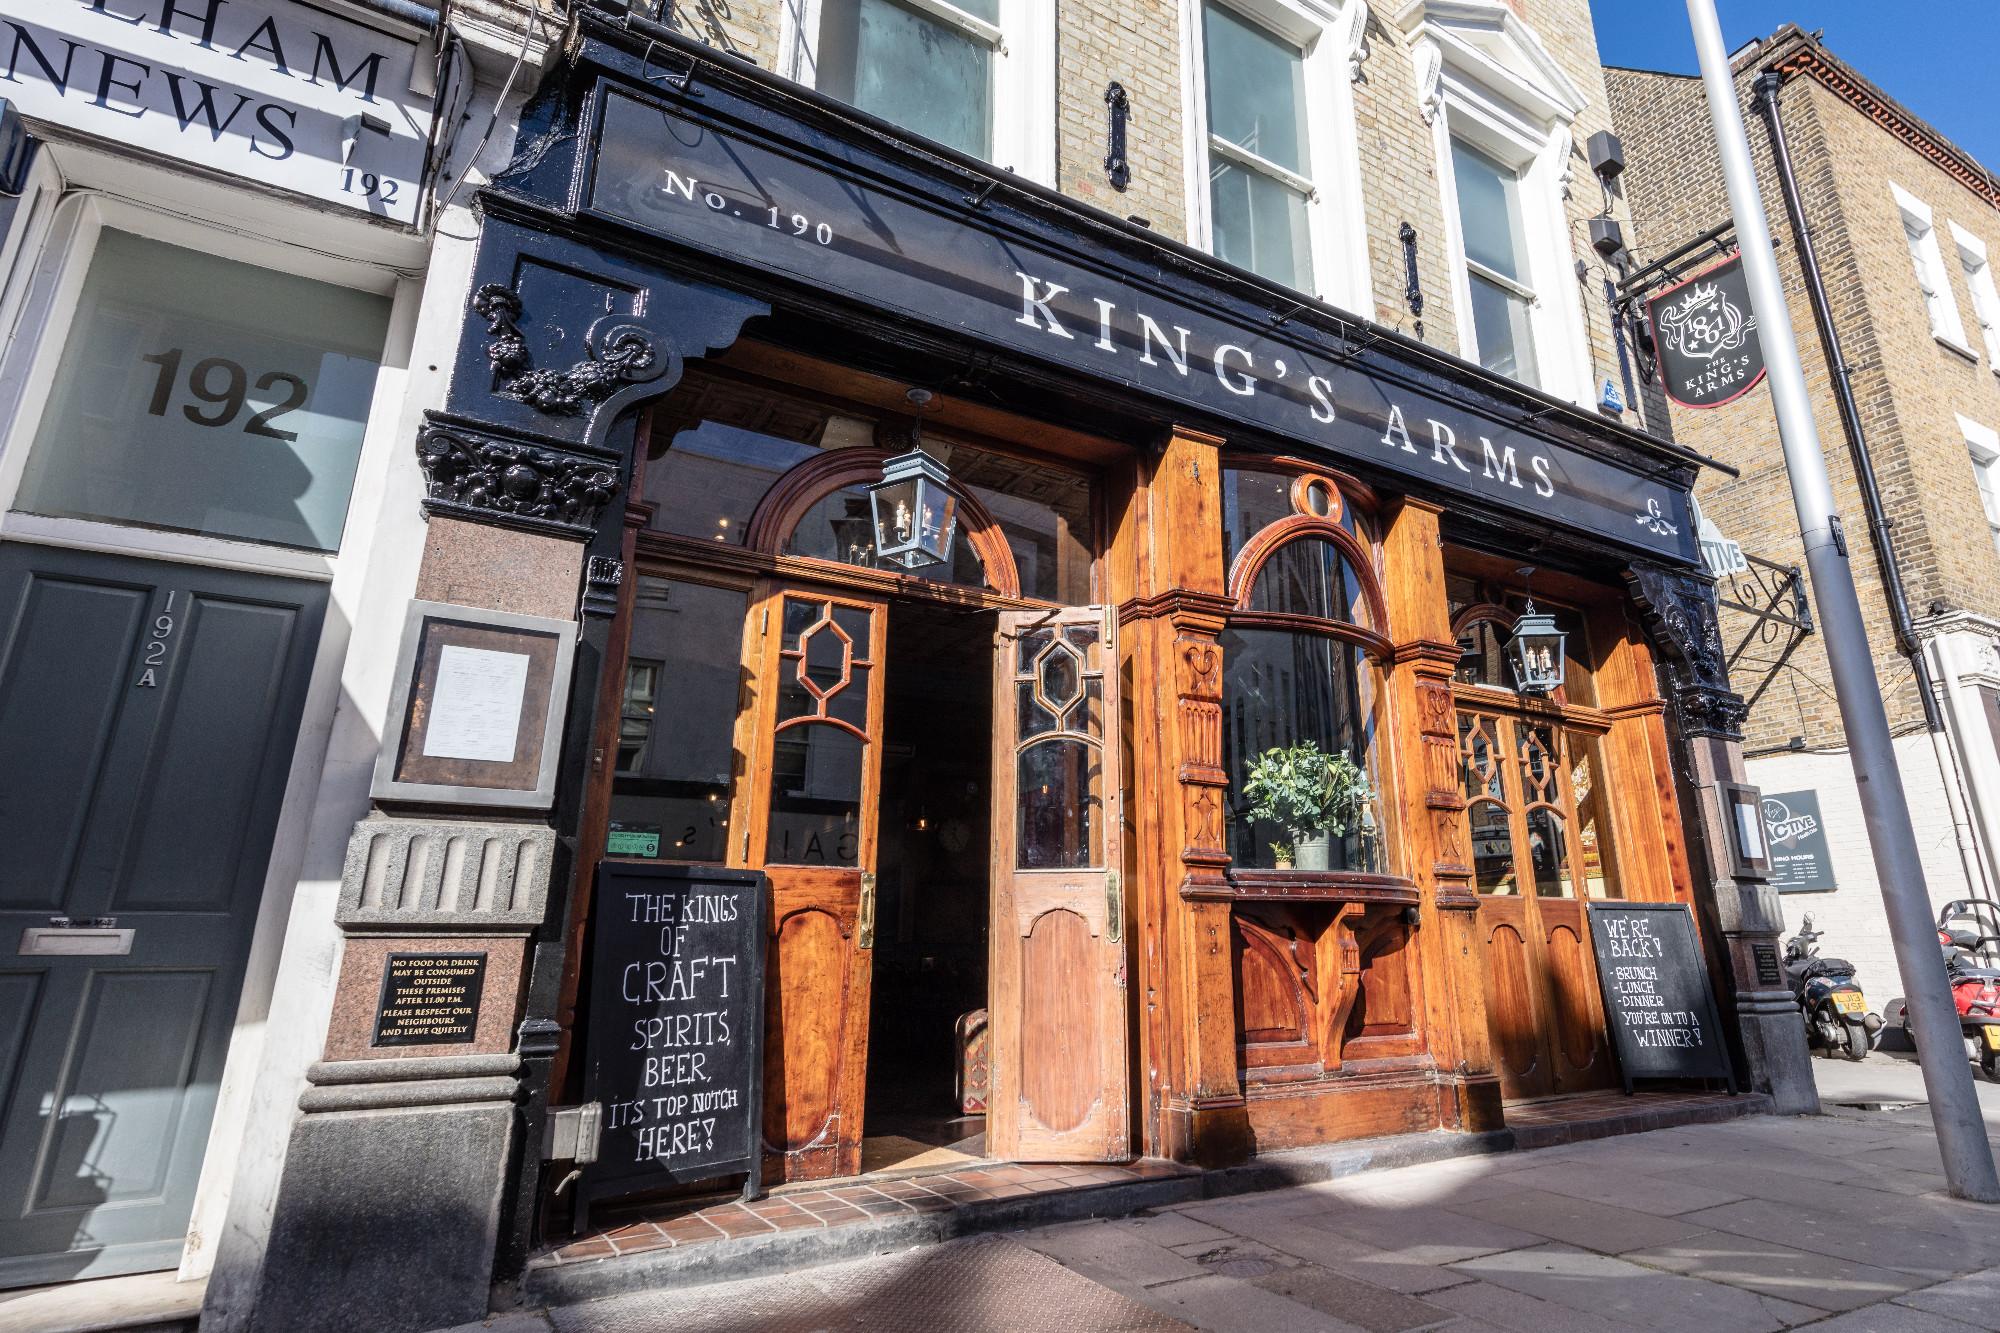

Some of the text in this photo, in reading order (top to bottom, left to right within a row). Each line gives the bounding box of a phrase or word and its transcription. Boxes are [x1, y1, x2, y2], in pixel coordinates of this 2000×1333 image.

[0, 20, 297, 161] NEWS
[339, 167, 399, 205] 192
[662, 169, 833, 245] No. 190
[1685, 315, 1726, 343] 1861
[1706, 357, 1726, 369] THE
[143, 347, 308, 442] 192
[1015, 271, 1554, 498] KING'S ARMS
[1695, 369, 1745, 398] ARMS
[1701, 539, 1744, 572] TIVE
[625, 893, 739, 924] THE KINGS
[661, 924, 689, 957] OF
[1603, 915, 1652, 939] WE'RE
[426, 968, 475, 976] CONSUMED
[622, 955, 736, 1006] CRAFT
[395, 997, 422, 1005] AFTER
[415, 1008, 451, 1016] RESPECT
[381, 1026, 468, 1036] AND LEAVE QUIETLY
[397, 1017, 455, 1026] NEIGHBOURS
[630, 1009, 731, 1050] SPIRITS,
[1621, 1010, 1699, 1026] YOU'RE ON TO A
[644, 1052, 712, 1088] BEER,
[608, 1088, 739, 1129] IT'S TOP NOTCH
[635, 1118, 716, 1162] HERE!
